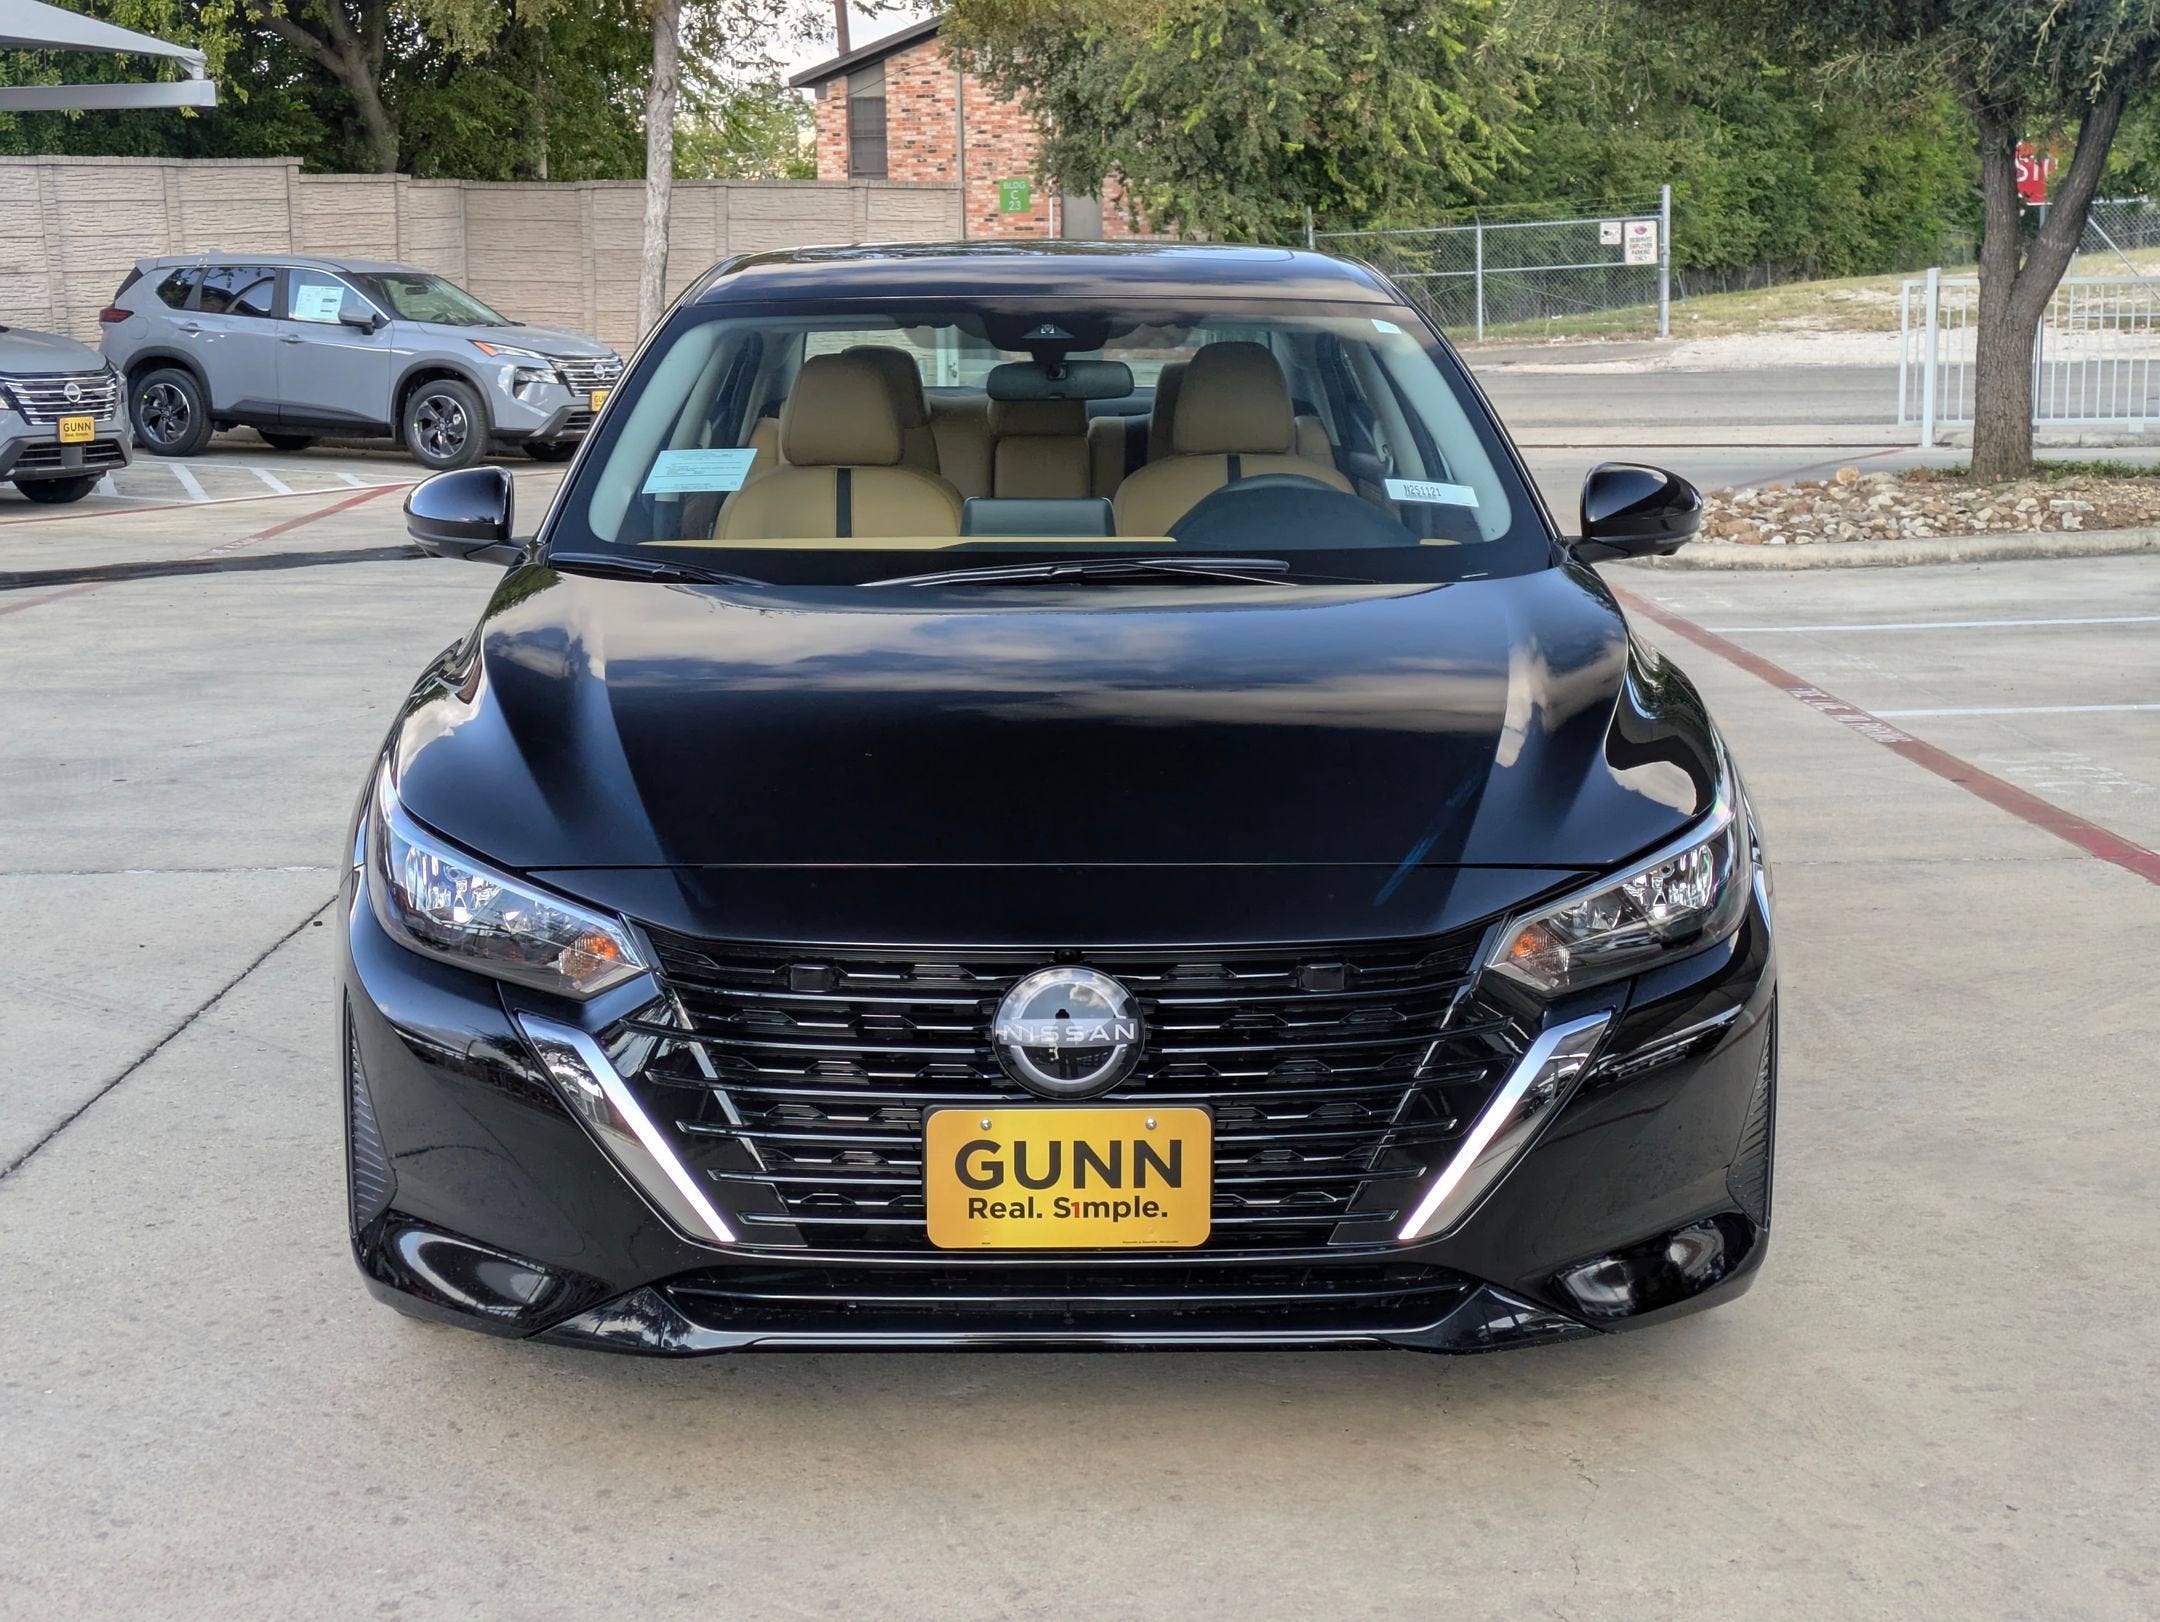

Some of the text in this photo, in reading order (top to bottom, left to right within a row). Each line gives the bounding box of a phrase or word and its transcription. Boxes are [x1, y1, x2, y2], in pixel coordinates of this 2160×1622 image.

[1003, 181, 1026, 189] BLDG
[1010, 190, 1019, 200] C
[1008, 200, 1021, 210] 23
[63, 422, 91, 432] GUNN
[1403, 484, 1442, 497] N251121
[1003, 1023, 1135, 1042] NISSAN
[955, 1139, 1182, 1190] GUNN
[968, 1196, 1043, 1219] Real.
